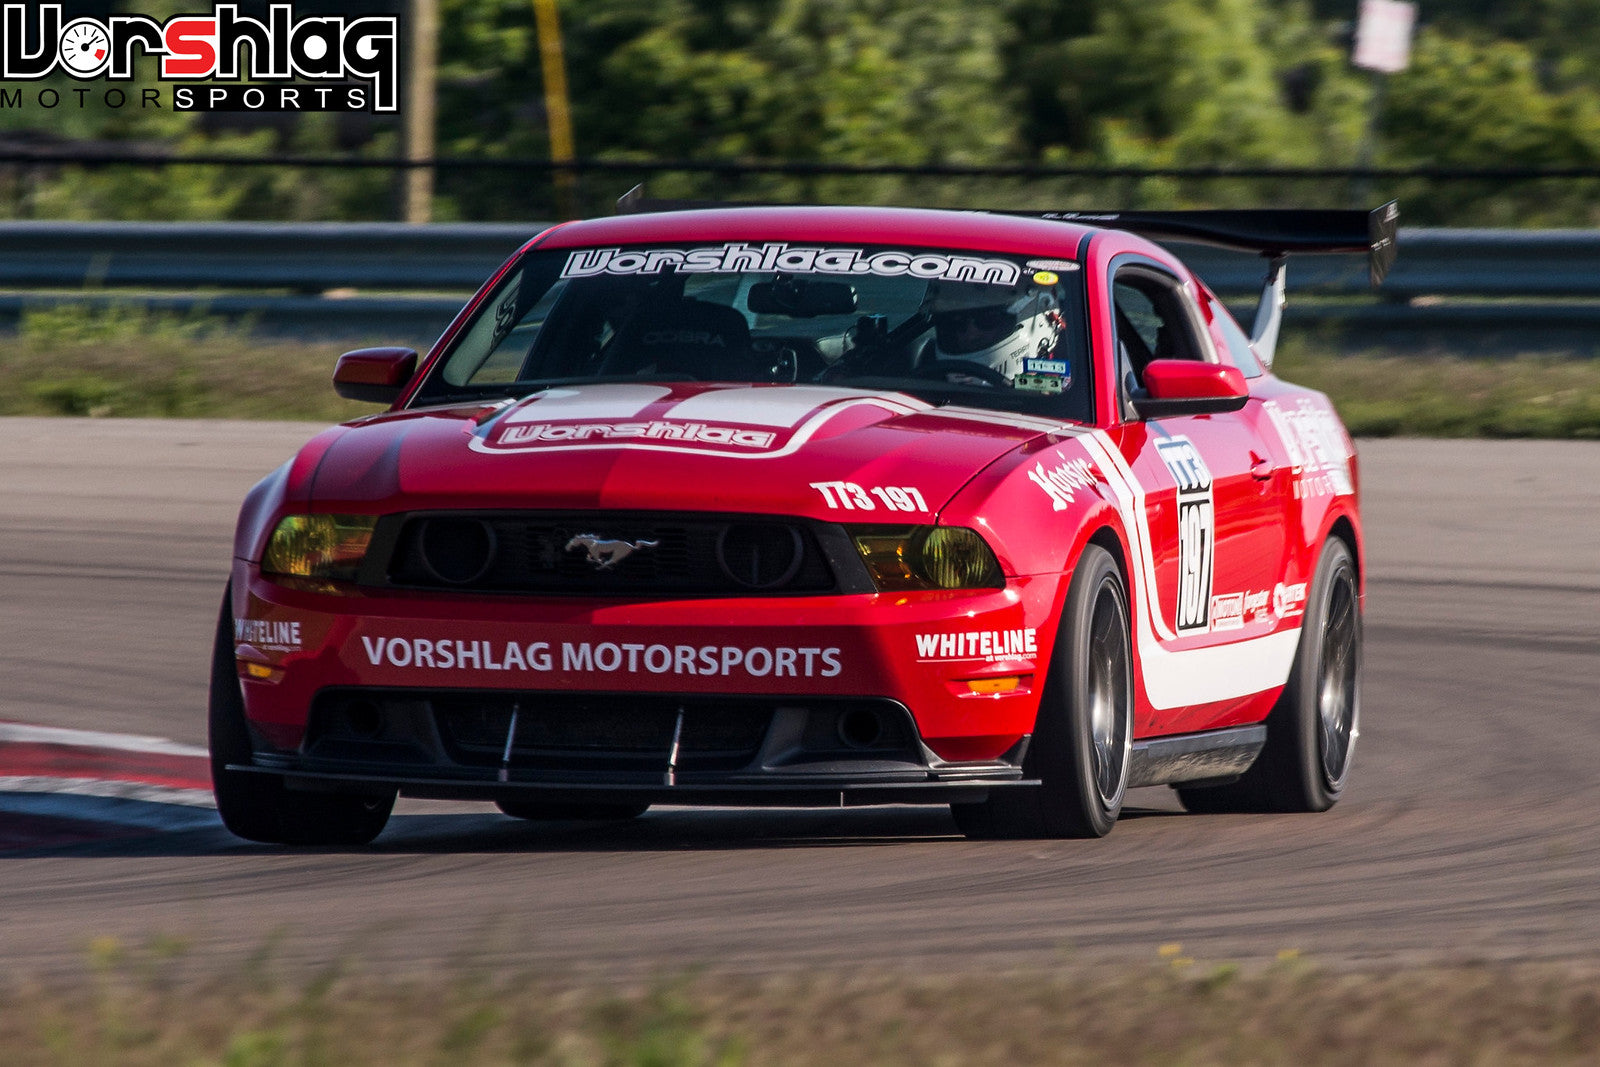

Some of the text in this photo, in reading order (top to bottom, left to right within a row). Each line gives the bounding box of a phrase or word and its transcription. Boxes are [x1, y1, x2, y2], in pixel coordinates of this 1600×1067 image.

[560, 243, 1021, 285] Vorshlag.com
[497, 420, 776, 448] Vorshlag
[1158, 442, 1211, 492] TT3
[809, 481, 929, 513] TT3 197
[1178, 502, 1210, 629] 197
[361, 636, 842, 678] VORSHLAG MOTORSPORTS
[915, 628, 1037, 657] WHITELINE
